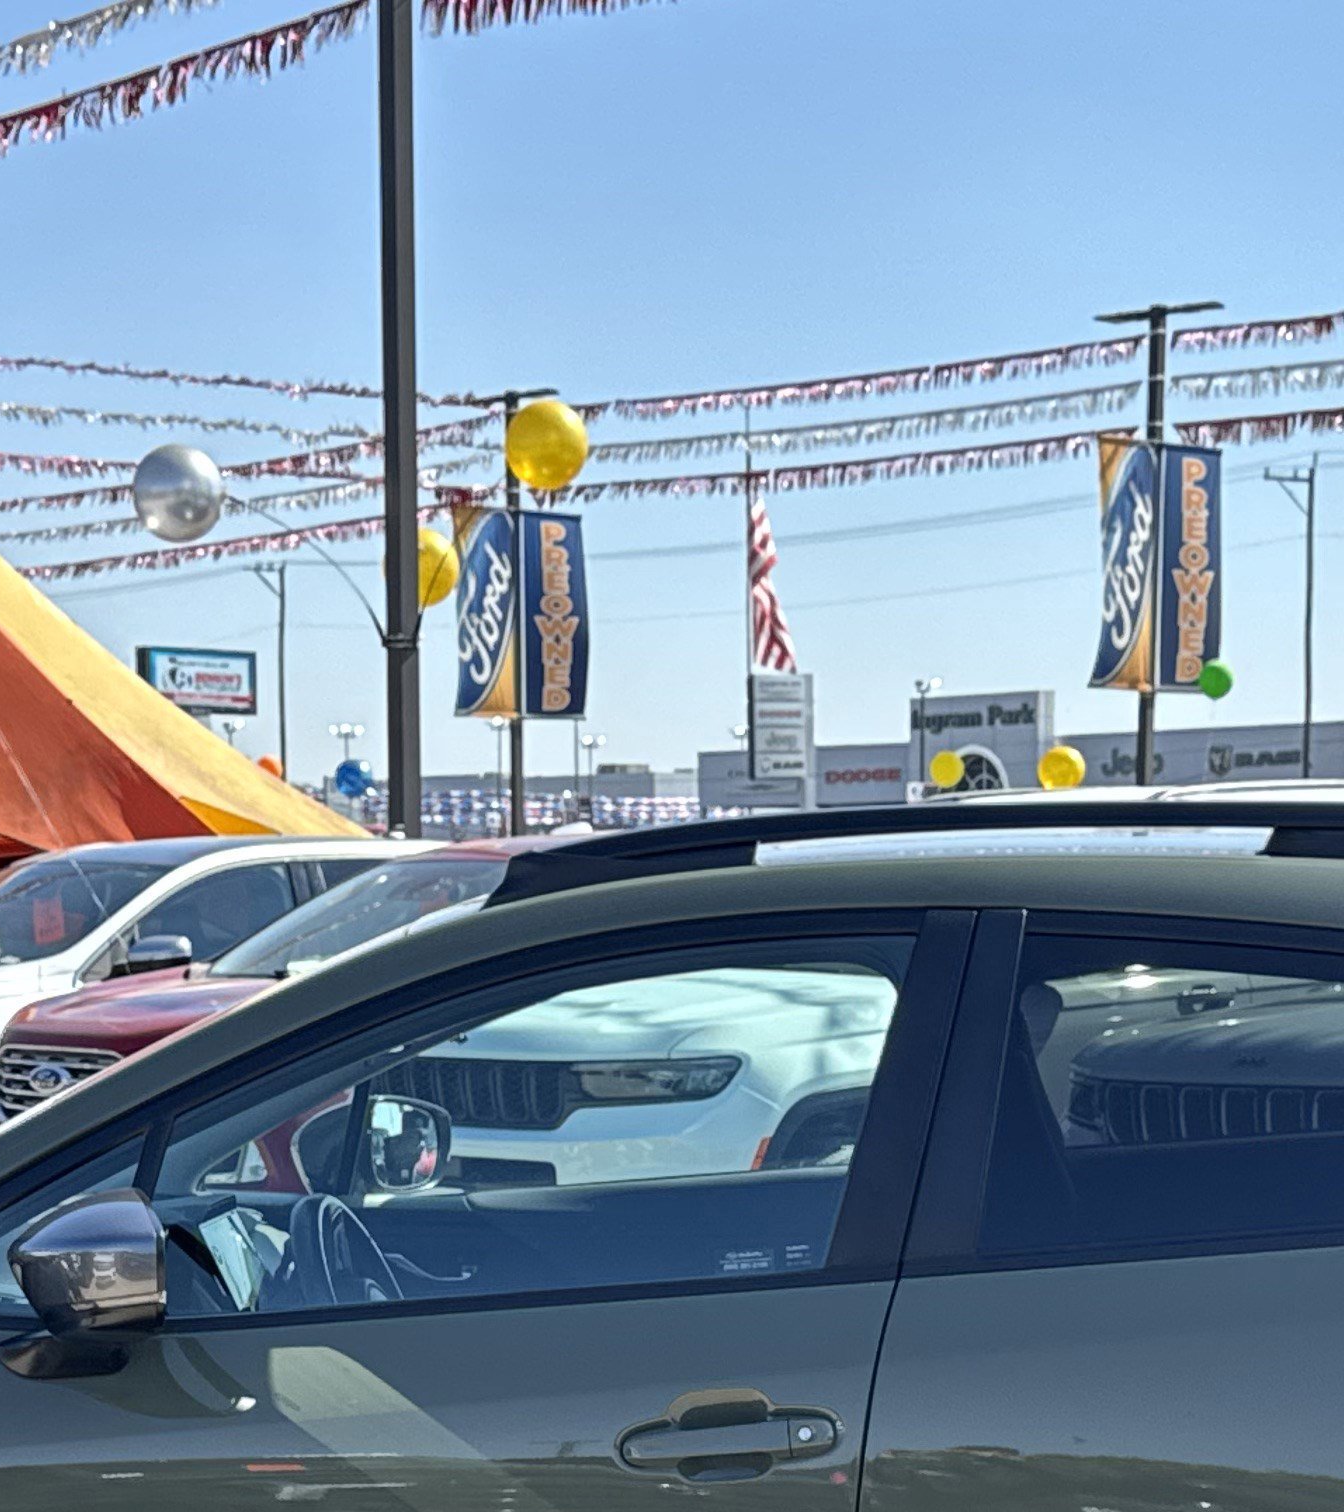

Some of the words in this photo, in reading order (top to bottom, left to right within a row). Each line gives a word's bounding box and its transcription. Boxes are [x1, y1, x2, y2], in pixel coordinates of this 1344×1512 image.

[459, 541, 512, 685] Ford
[533, 520, 580, 712] PREOWNED
[1102, 480, 1153, 650] Ford
[1171, 456, 1214, 683] PREOWNED
[824, 767, 902, 785] DODGE
[987, 703, 1036, 726] Park
[1100, 747, 1164, 777] Jep
